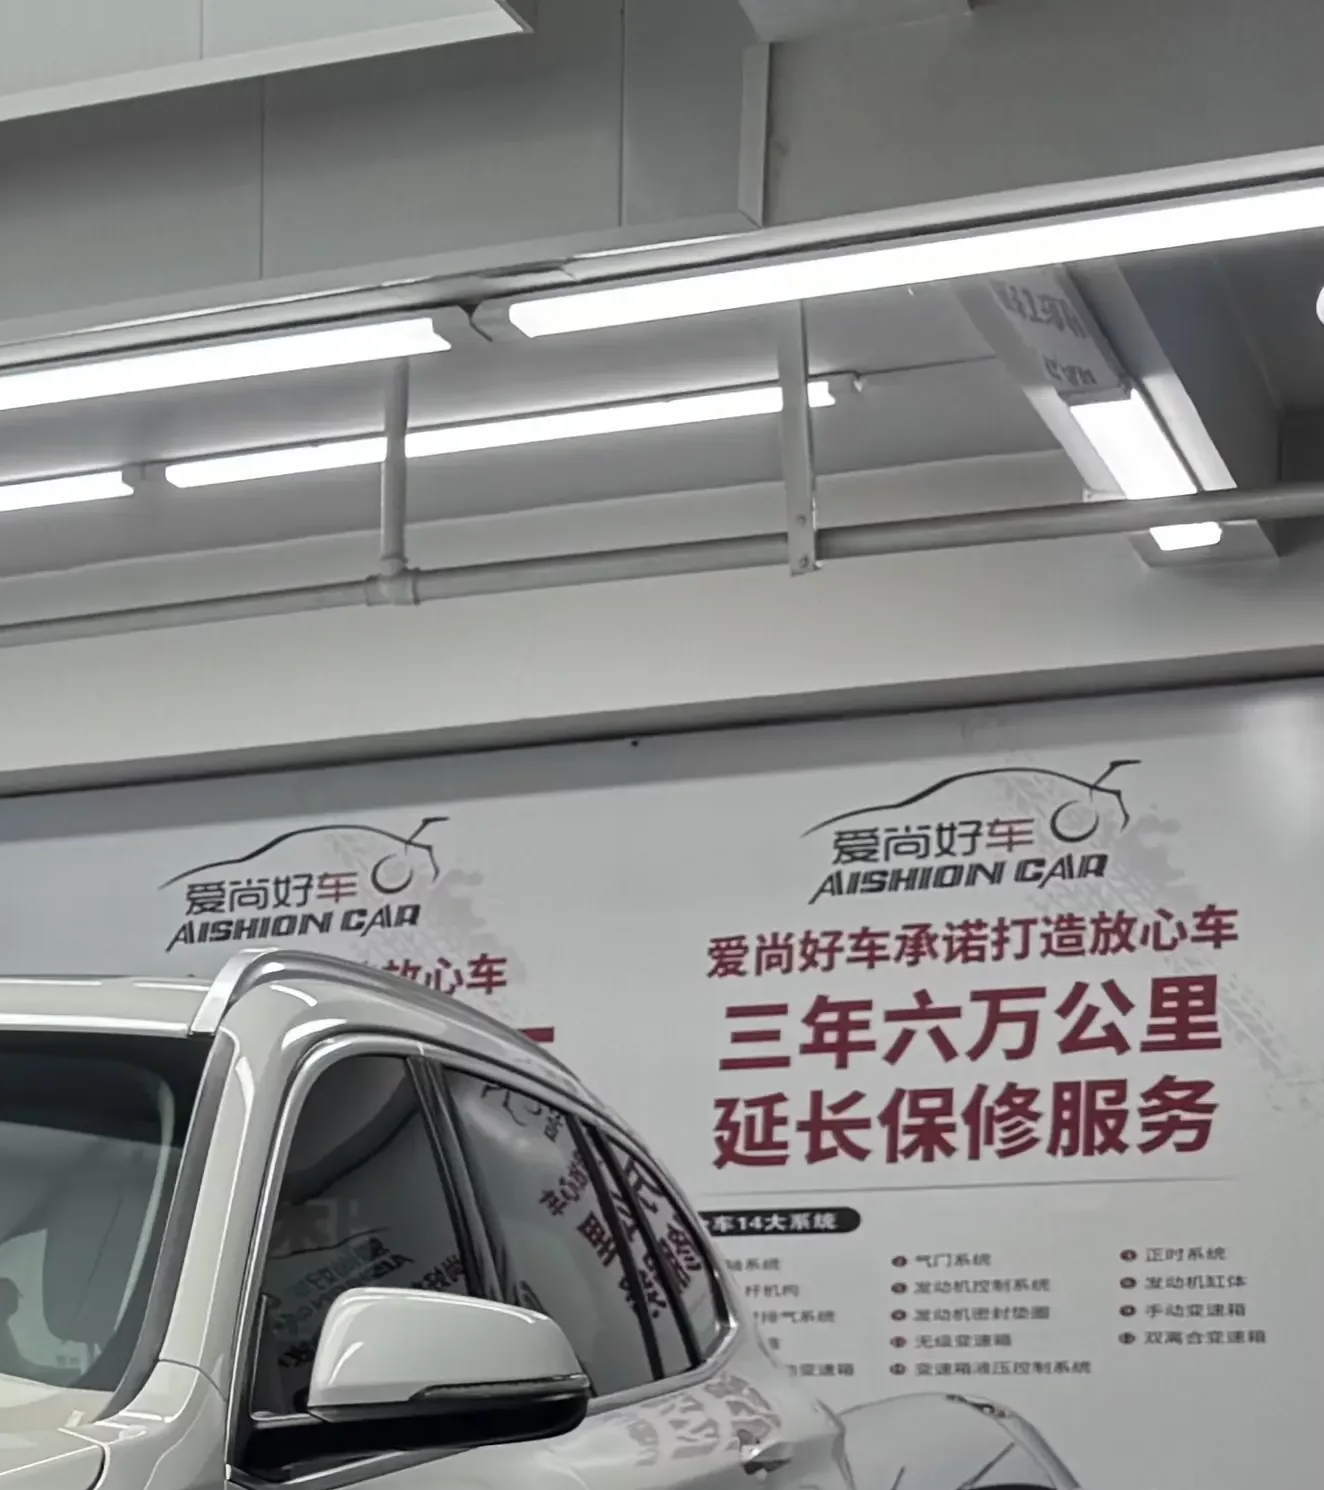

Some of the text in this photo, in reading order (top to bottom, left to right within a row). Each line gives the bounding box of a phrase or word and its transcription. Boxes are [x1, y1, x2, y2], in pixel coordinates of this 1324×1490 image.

[831, 818, 1035, 865] 爱尚好车
[185, 871, 358, 917] 爱尚好车
[807, 852, 1109, 905] AISHION CAR
[165, 903, 421, 953] AISHION CAR
[707, 904, 1239, 978] 爱尚好车承诺打造放心车
[719, 974, 1223, 1071] 三年六万公里
[712, 1074, 1220, 1170] 延长保修服务
